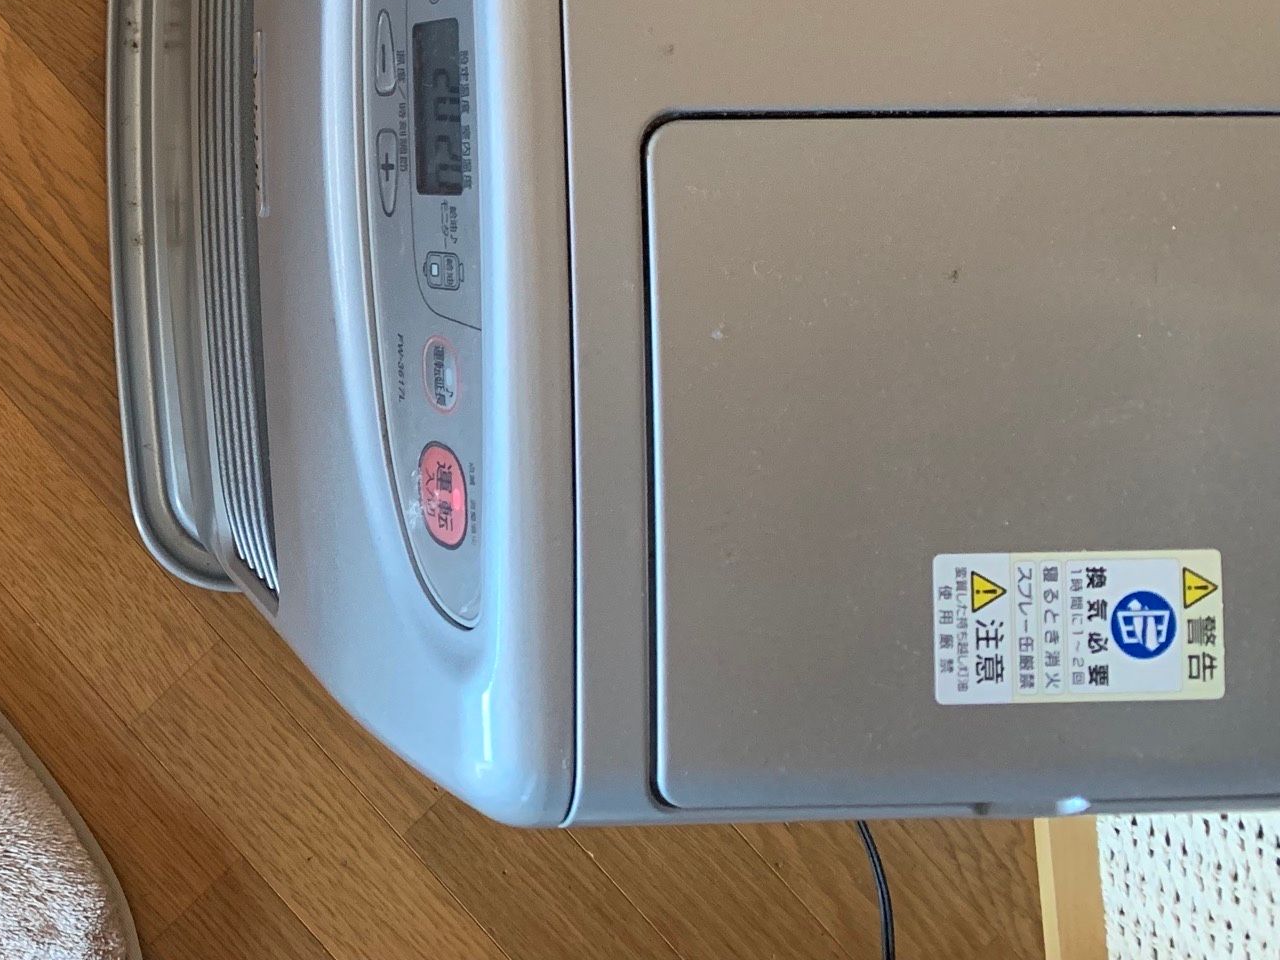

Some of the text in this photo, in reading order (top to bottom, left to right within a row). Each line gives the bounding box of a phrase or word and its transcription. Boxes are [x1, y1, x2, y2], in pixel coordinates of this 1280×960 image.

[460, 50, 472, 189] 設定温度 室内温度
[397, 333, 406, 402] FW-3617L
[436, 461, 453, 532] 運転
[938, 585, 954, 674] 使用厳禁
[955, 566, 969, 693] 変質した持ち越し灯油
[975, 619, 1005, 684] 注意
[1017, 566, 1034, 689] スプレー缶厳禁
[1042, 566, 1061, 689] 寝るとき消火
[1085, 566, 1109, 687] 換気必要
[1187, 615, 1218, 682] 警告
